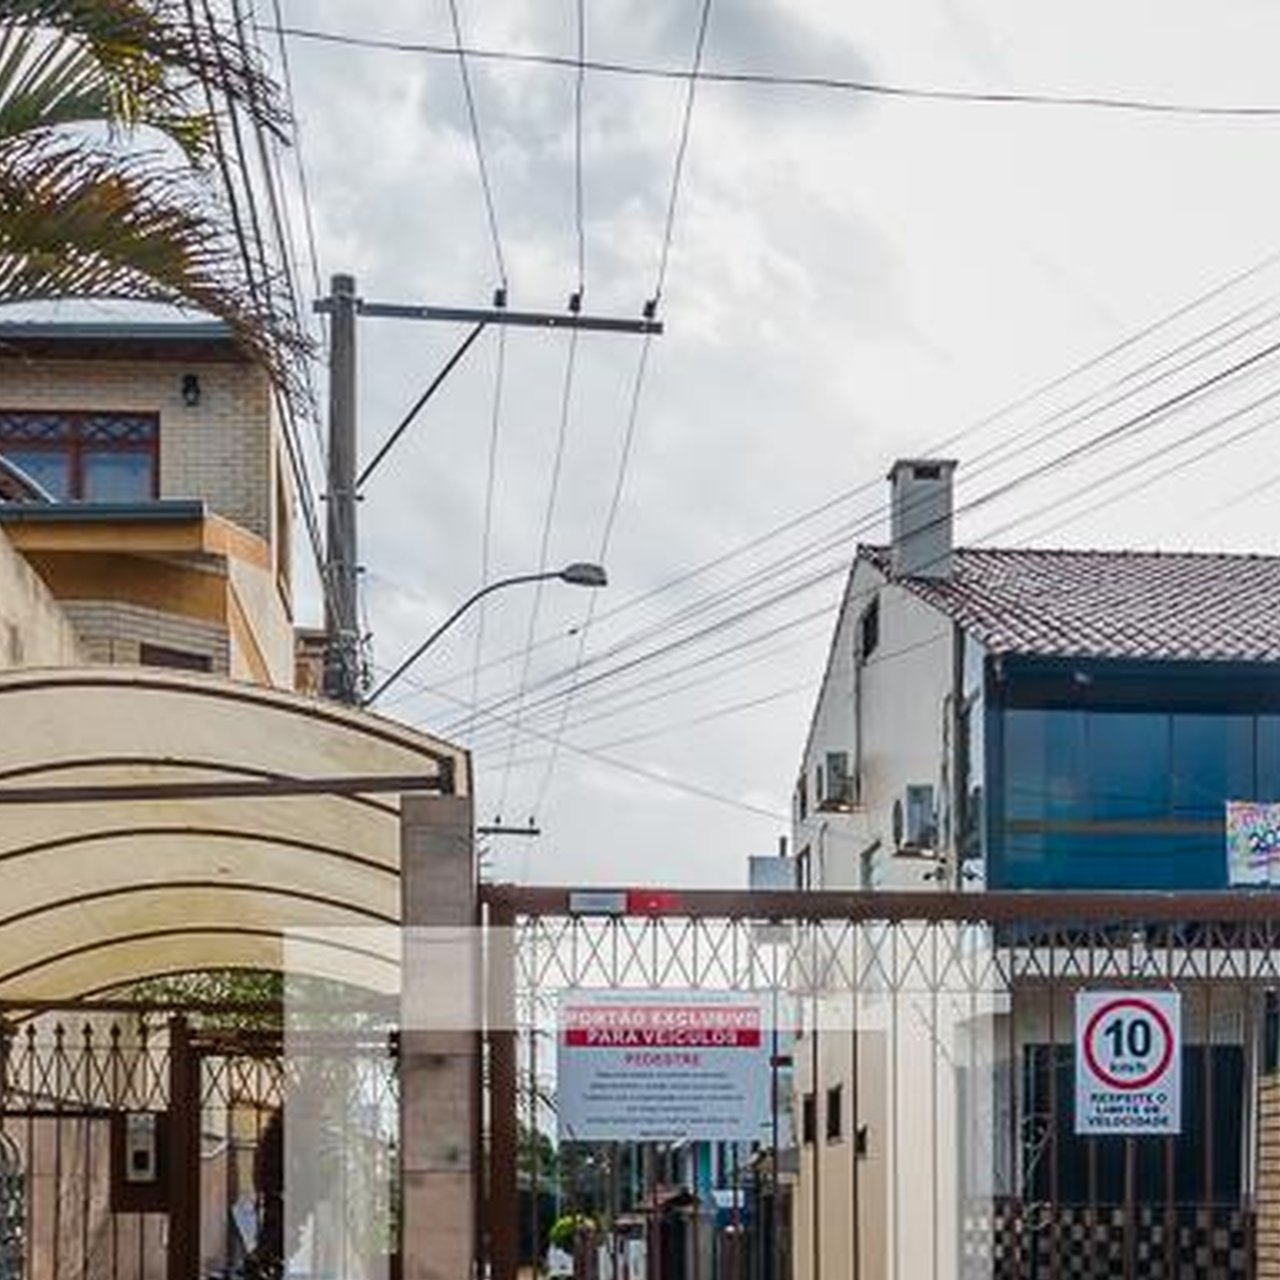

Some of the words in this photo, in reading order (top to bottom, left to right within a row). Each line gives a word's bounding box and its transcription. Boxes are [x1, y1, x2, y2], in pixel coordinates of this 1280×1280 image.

[651, 1009, 759, 1028] EXCLUSIVO
[586, 1028, 640, 1046] PARA
[1104, 1018, 1151, 1058] 10
[1156, 1093, 1168, 1104] O
